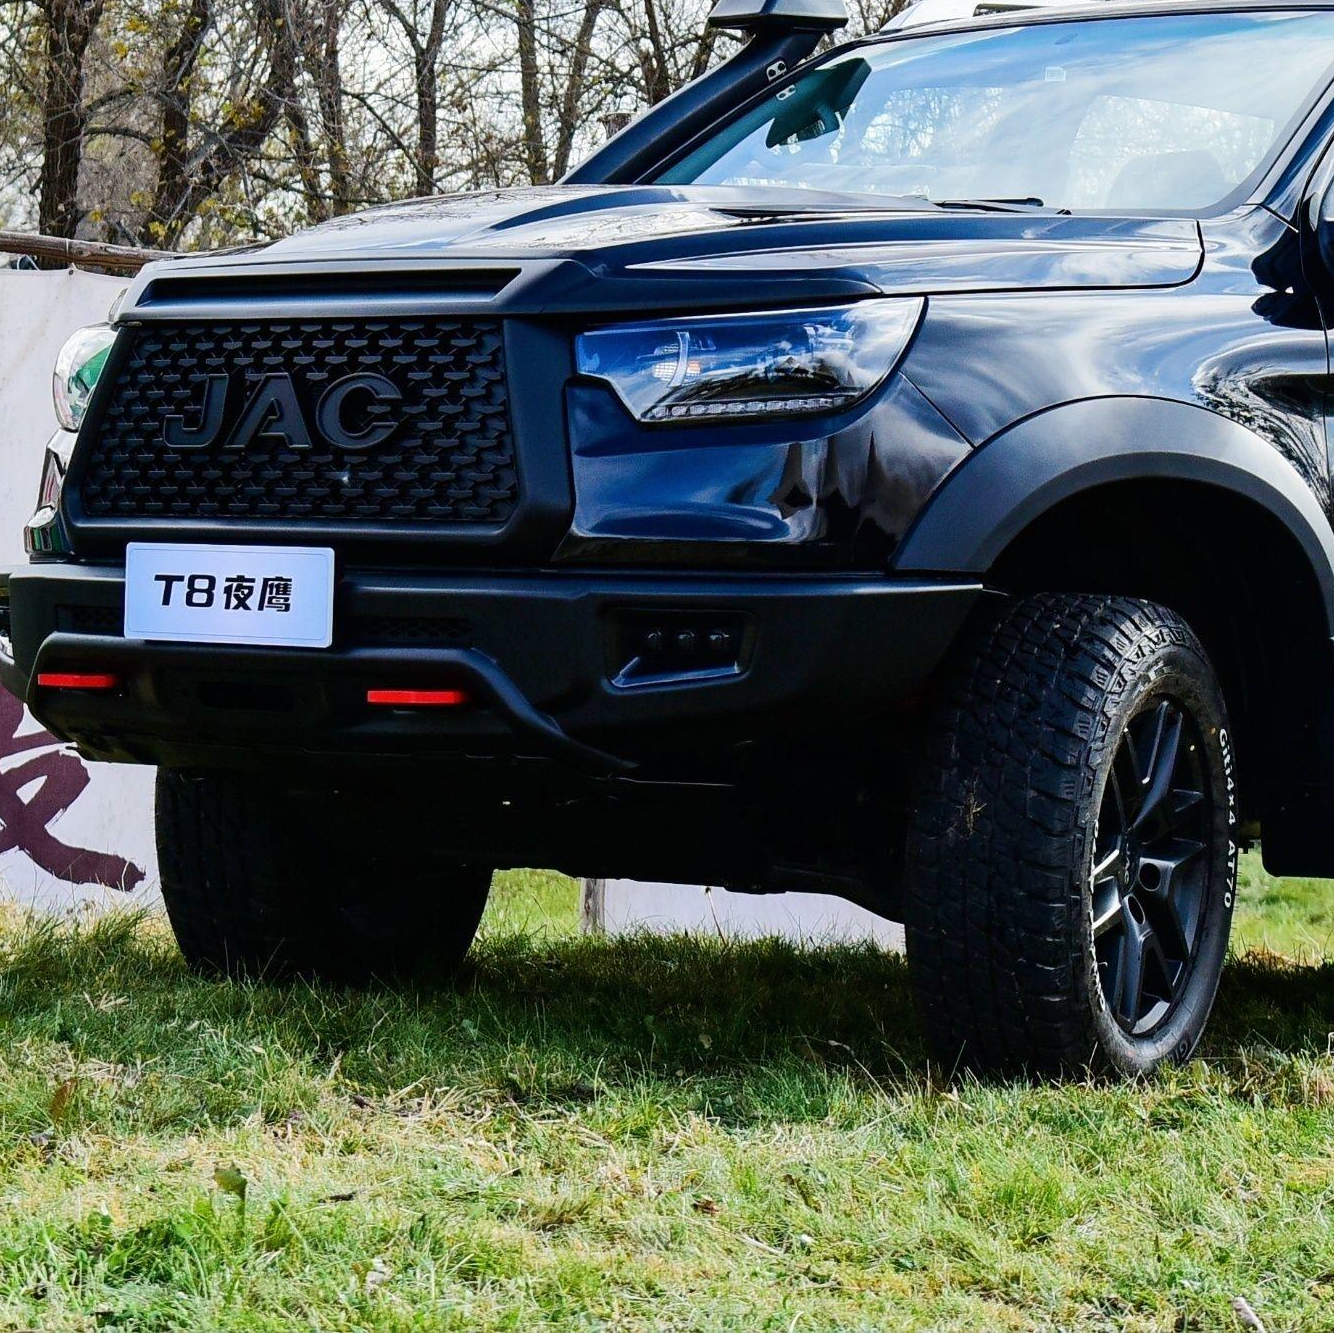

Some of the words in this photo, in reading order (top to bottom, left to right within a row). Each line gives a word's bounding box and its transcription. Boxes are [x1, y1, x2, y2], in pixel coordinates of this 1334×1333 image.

[163, 371, 403, 450] JAC
[153, 573, 294, 613] T8夜鹰
[1224, 839, 1237, 909] AT70
